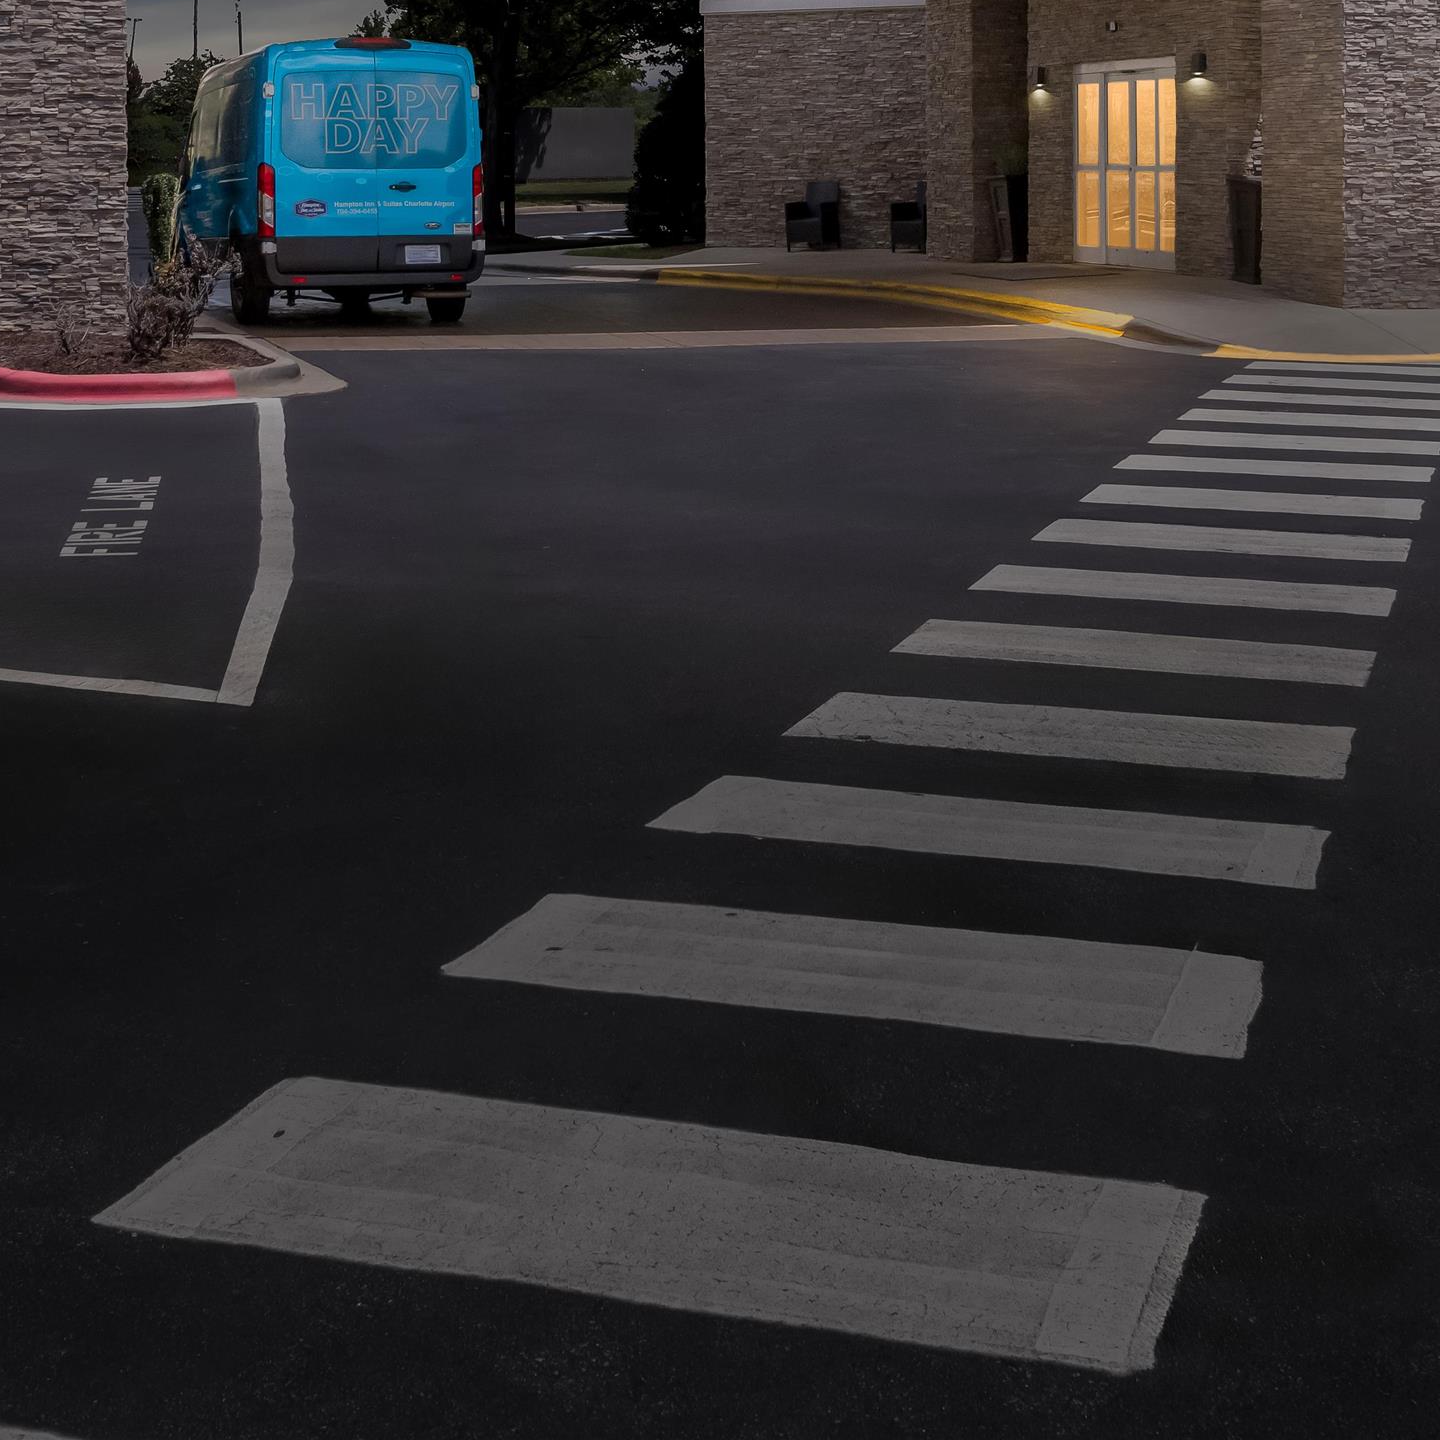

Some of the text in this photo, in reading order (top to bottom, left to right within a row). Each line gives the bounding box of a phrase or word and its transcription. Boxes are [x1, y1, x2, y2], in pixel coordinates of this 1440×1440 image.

[290, 83, 459, 120] HAPPY
[324, 118, 429, 154] DAY
[334, 200, 364, 209] Hampton
[433, 200, 455, 208] Airport
[59, 475, 162, 557] FIRE LANE
